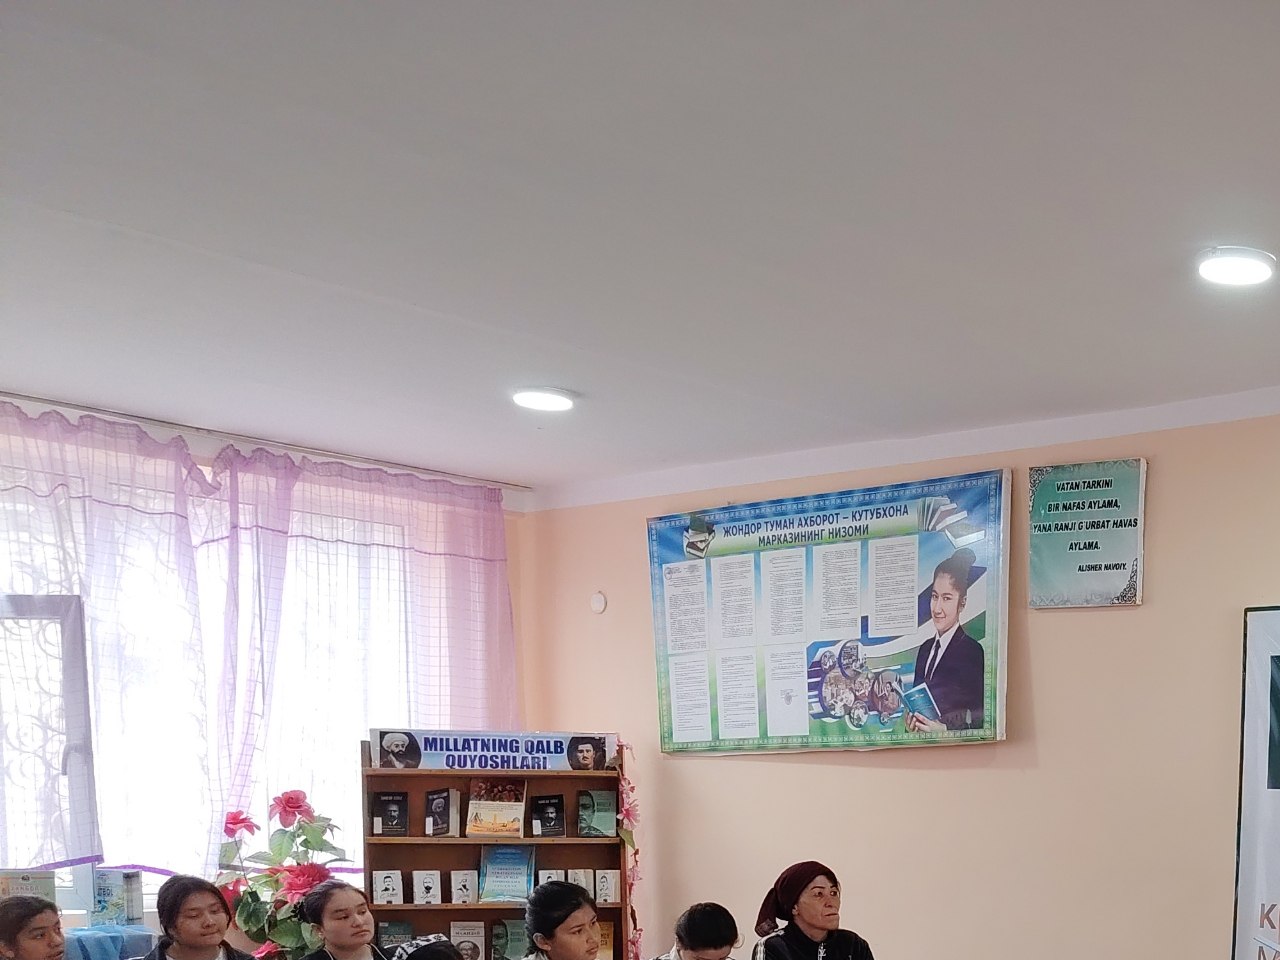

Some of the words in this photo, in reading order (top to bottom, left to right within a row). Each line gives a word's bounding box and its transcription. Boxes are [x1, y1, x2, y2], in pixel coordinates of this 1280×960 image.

[1056, 480, 1080, 492] VATAN
[1082, 479, 1113, 491] TARKINI
[1047, 501, 1060, 513] BIR
[1062, 500, 1086, 512] NAFAS
[1087, 498, 1121, 511] AYLAMA,
[723, 522, 762, 538] ЖОНДОР
[763, 518, 795, 532] ТУМАН
[797, 512, 840, 529] АХБОРОТ
[851, 504, 909, 523] КУТУБХОНА
[1033, 523, 1052, 533] YANA
[1054, 521, 1076, 532] RANJI
[1112, 517, 1138, 528] HAVAS
[758, 529, 826, 547] МАРКАЗИНИНГ
[828, 523, 869, 539] НИЗОМИ
[1068, 540, 1101, 551] AYLAMA.
[1077, 563, 1102, 572] ALISHER
[423, 736, 520, 753] MILLATNING
[524, 738, 565, 755] QALB
[445, 754, 548, 770] QUYOSHLARI
